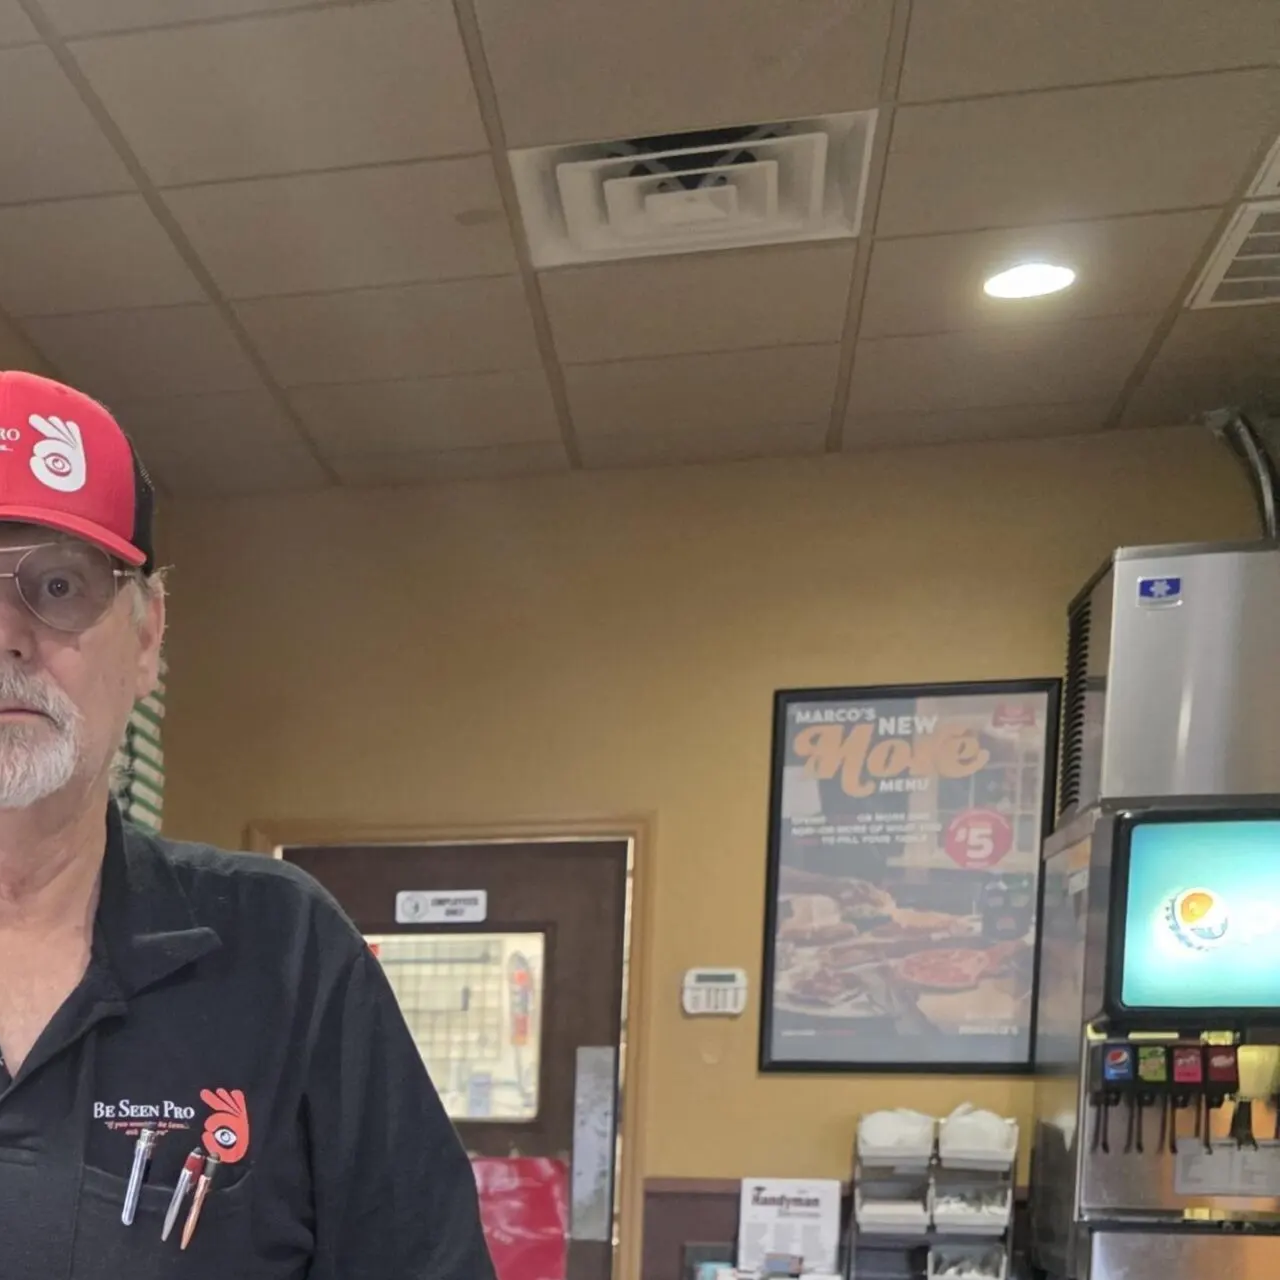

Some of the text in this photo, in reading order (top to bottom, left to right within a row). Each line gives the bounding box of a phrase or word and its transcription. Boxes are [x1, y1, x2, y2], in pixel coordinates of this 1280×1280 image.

[795, 707, 938, 735] MARCO'S NEW
[879, 779, 930, 793] MENU
